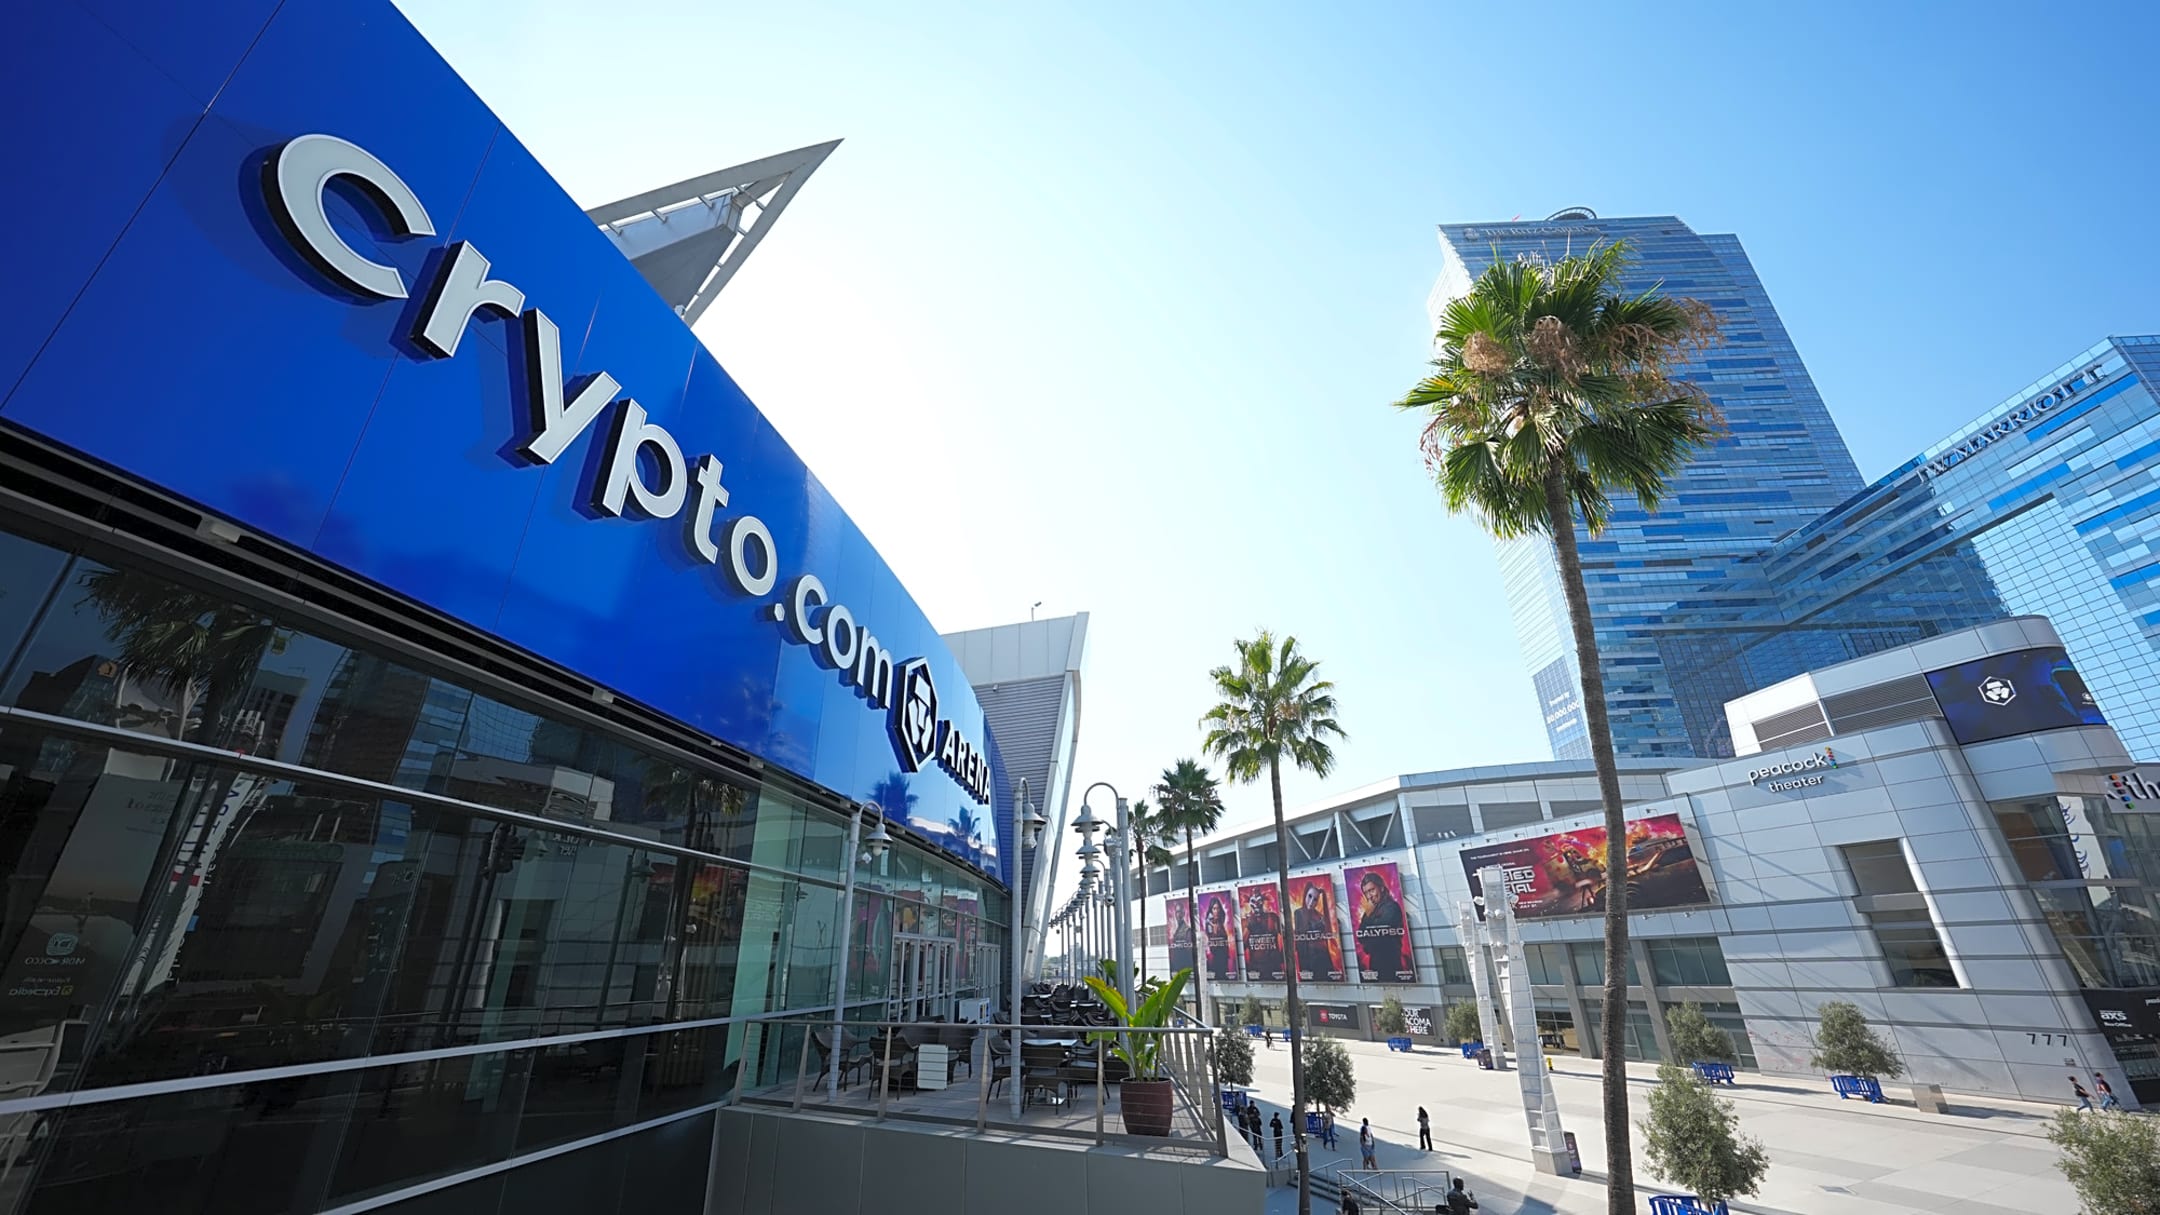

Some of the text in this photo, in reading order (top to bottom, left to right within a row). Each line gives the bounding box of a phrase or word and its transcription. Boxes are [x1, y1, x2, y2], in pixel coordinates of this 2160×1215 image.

[1952, 364, 2105, 462] MARRIOTT
[266, 133, 893, 712] crypto.com
[940, 719, 992, 805] ARENA
[1748, 752, 1828, 787] peacock
[1768, 775, 1824, 793] theater
[2122, 772, 2160, 800] th
[1356, 927, 1405, 938] CALYPSO
[1248, 936, 1276, 945] SWEET
[1250, 943, 1277, 951] TOOTH
[1328, 1012, 1348, 1021] TOYOTA
[1404, 1016, 1432, 1027] ACOMA
[2100, 1011, 2128, 1021] axs
[2026, 1033, 2067, 1047] 777
